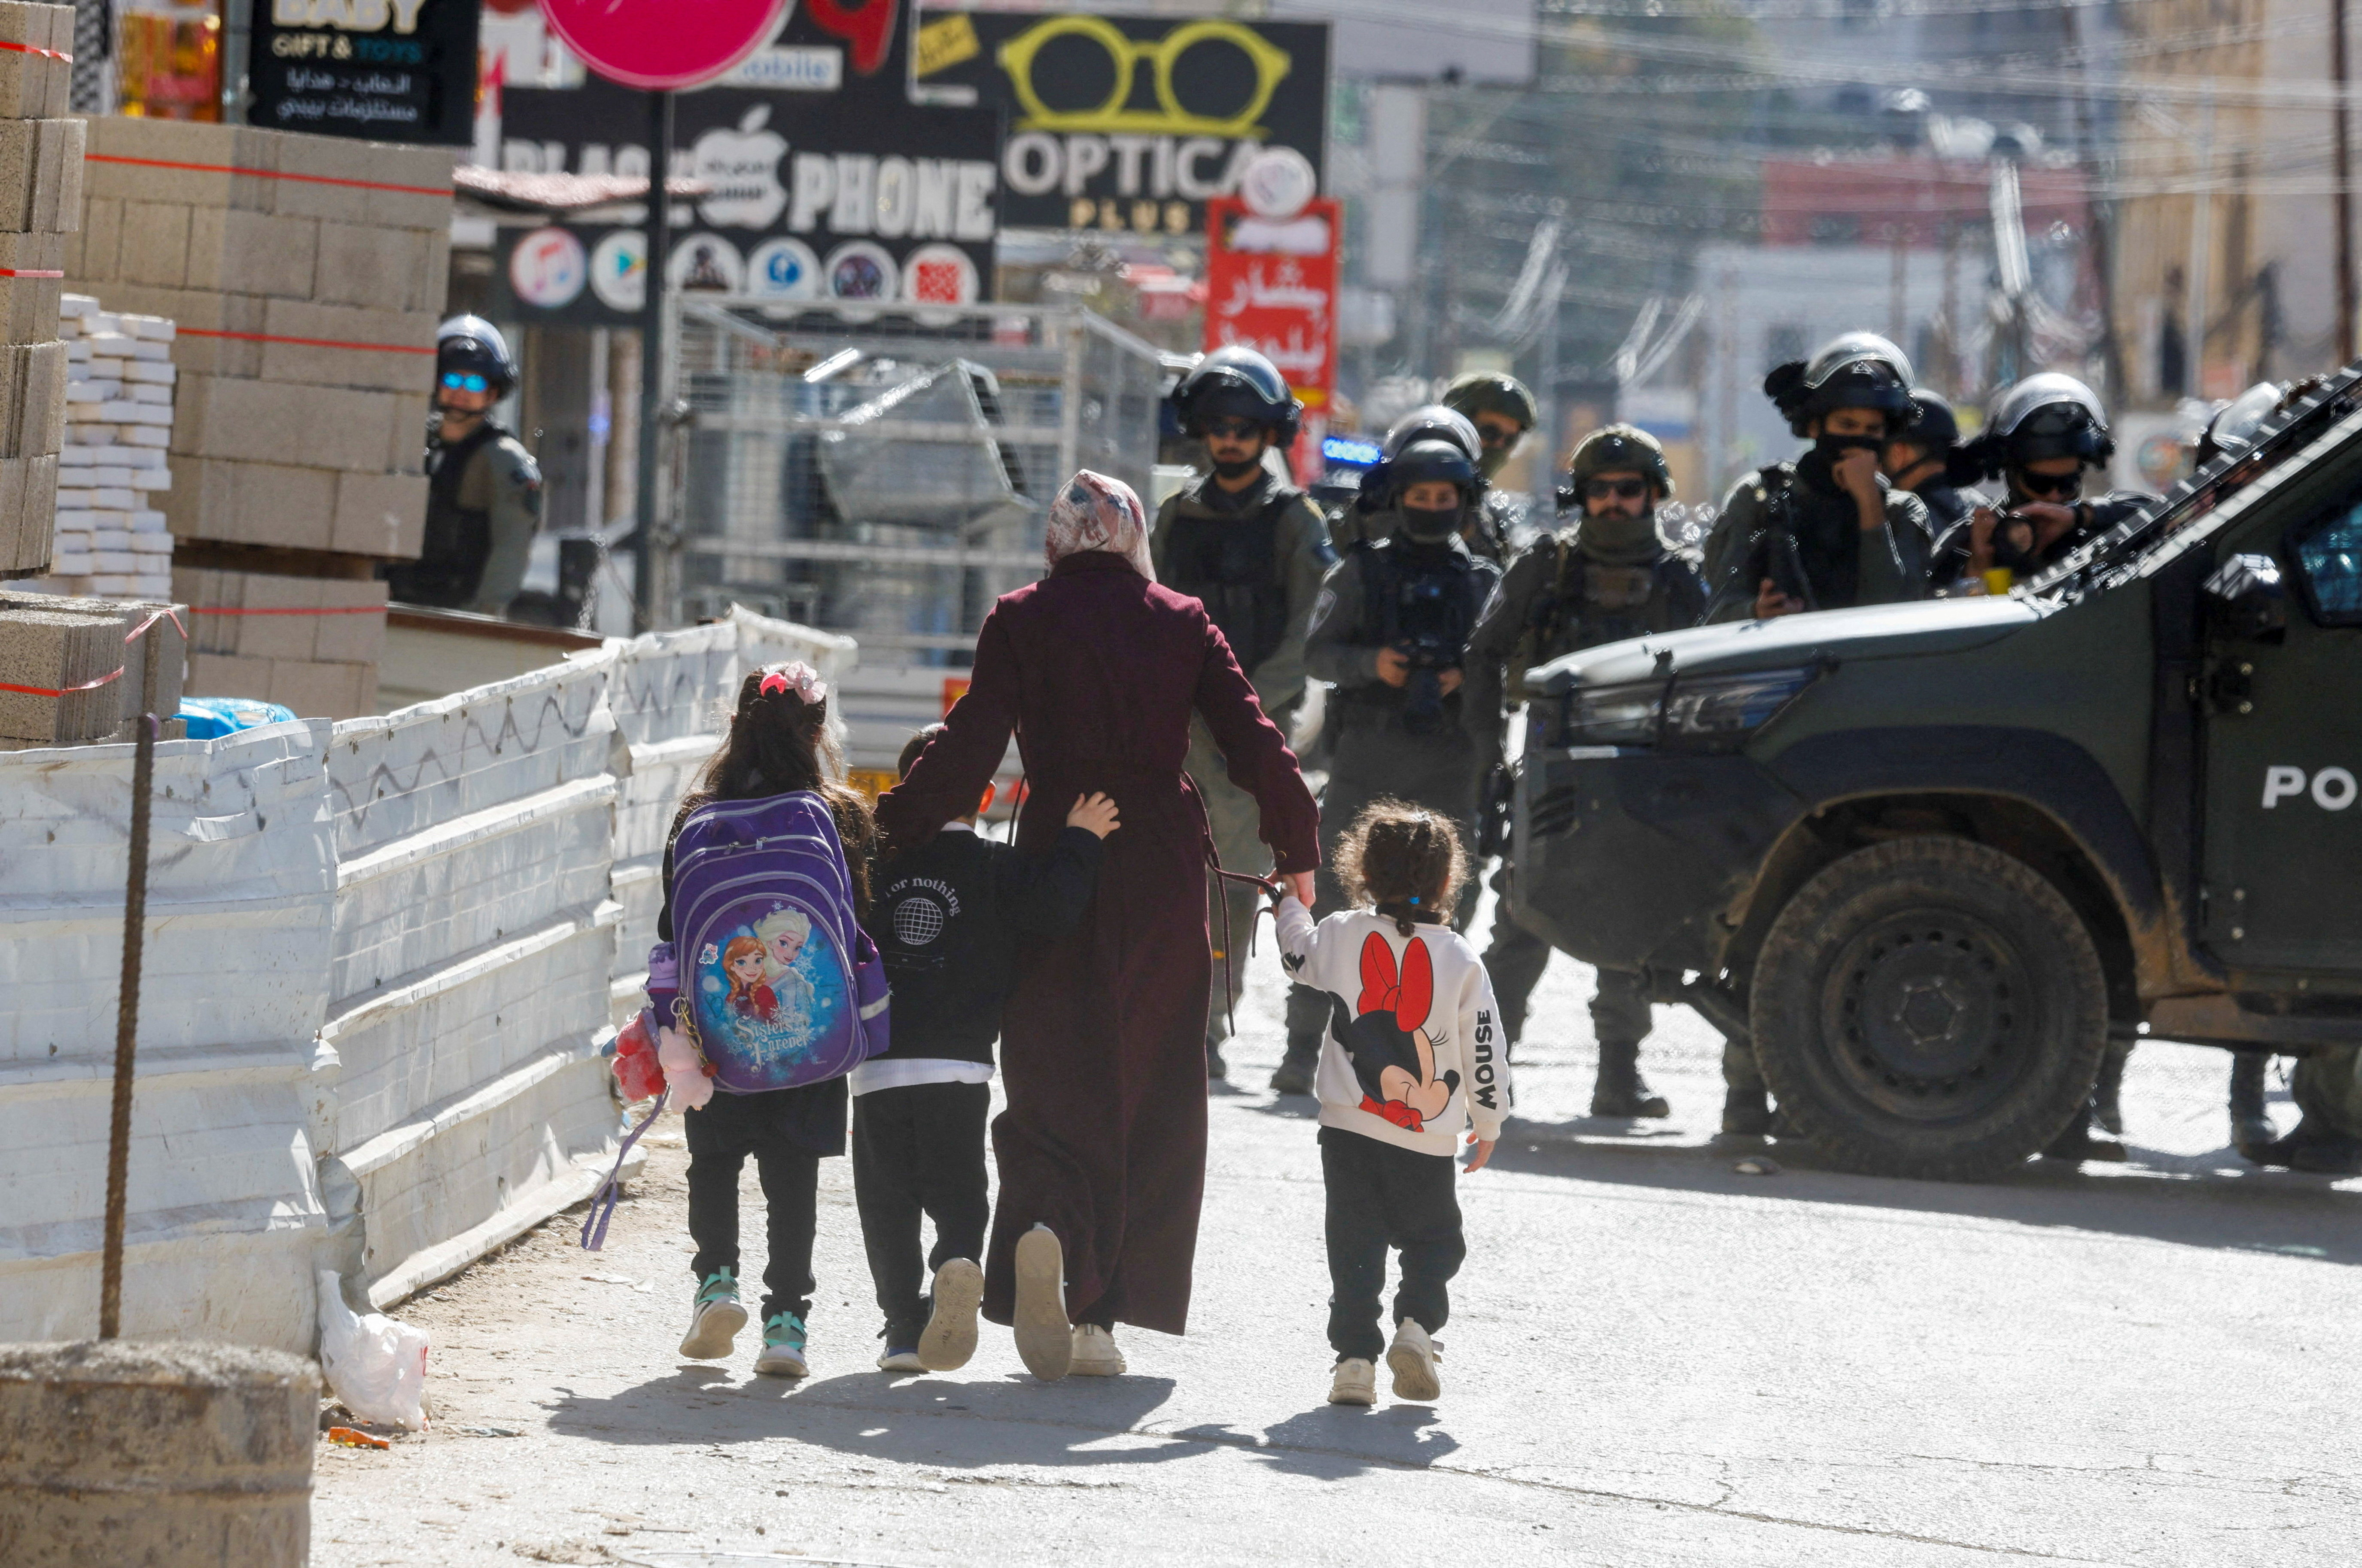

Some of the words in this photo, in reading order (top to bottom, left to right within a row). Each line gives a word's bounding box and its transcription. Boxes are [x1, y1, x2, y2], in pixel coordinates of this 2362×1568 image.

[272, 33, 331, 58] GIFT
[331, 34, 352, 60] &
[356, 38, 422, 64] TOYS
[744, 52, 831, 80] obile
[787, 151, 997, 243] PHONE
[1070, 198, 1191, 235] PLUS
[891, 879, 908, 892] or
[912, 877, 962, 917] nothing
[735, 1015, 794, 1049] Sisters
[751, 1034, 808, 1073] Forever
[1474, 1010, 1498, 1110] MOUSE
